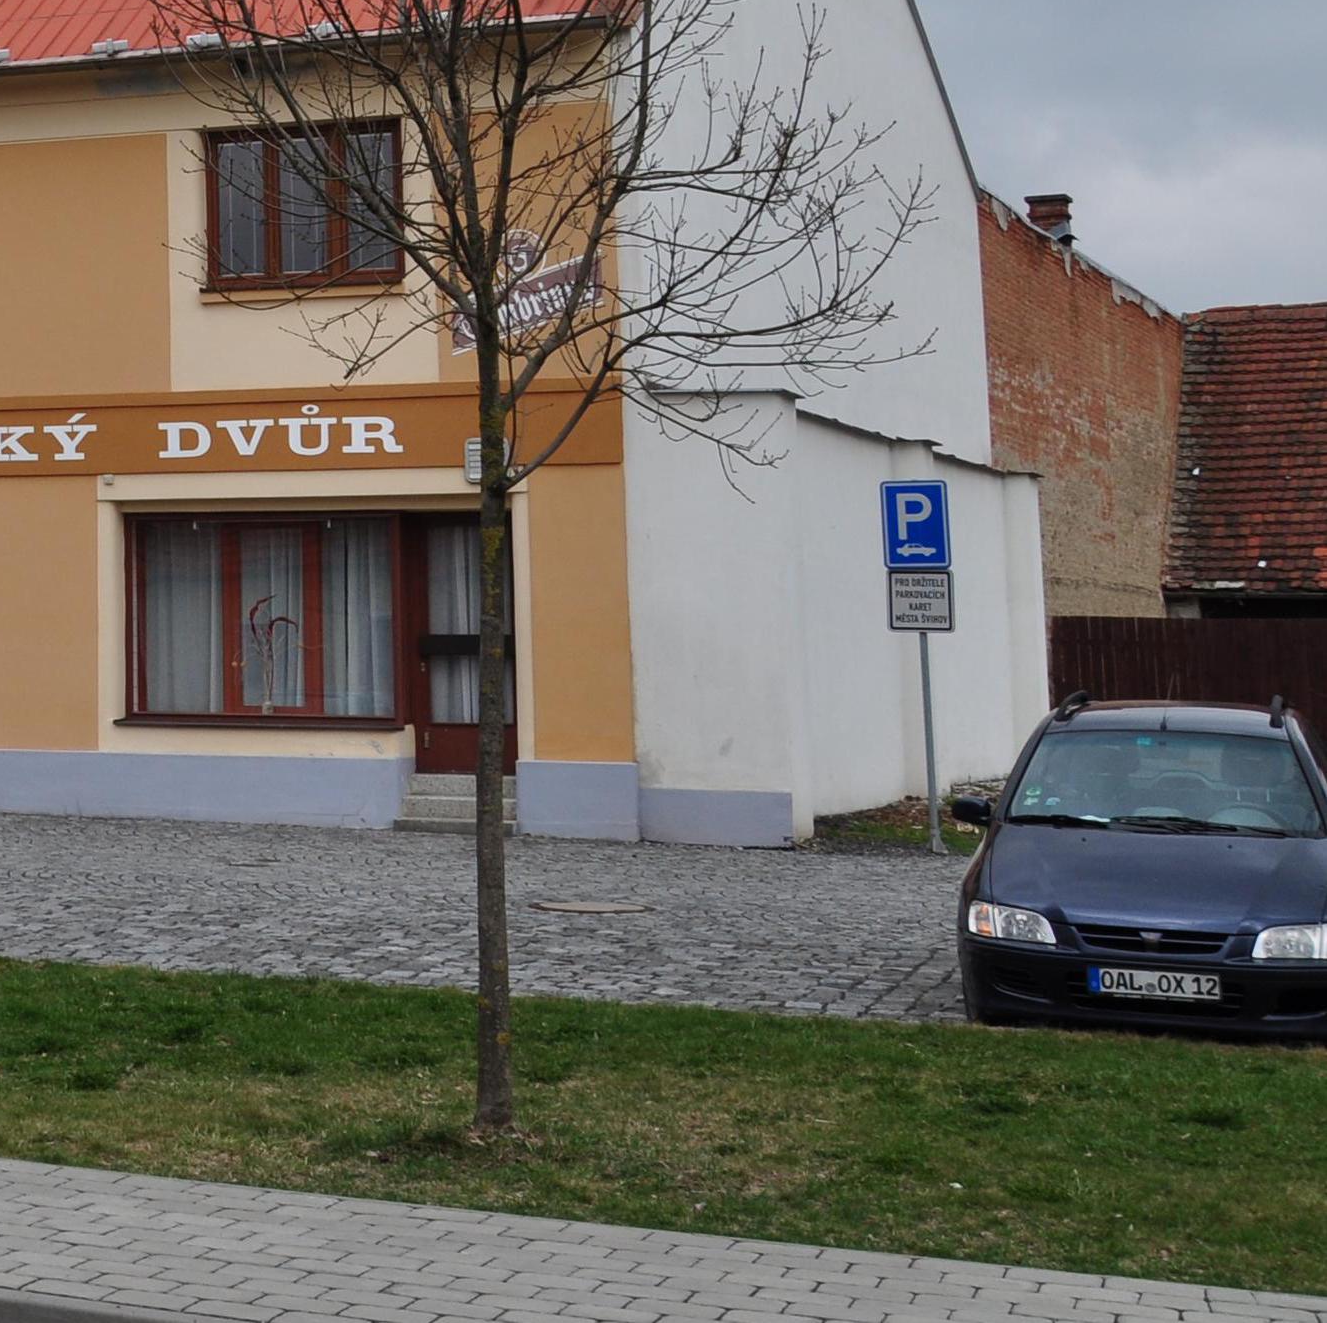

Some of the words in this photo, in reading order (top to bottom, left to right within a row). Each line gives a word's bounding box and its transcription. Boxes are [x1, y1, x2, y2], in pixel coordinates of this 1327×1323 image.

[158, 404, 404, 458] DVŮR
[896, 493, 932, 540] P
[895, 578, 909, 587] PRO
[911, 576, 945, 587] DRŽITELE
[895, 589, 945, 599] PARKOVACÍCH
[909, 602, 932, 611] KARET
[895, 612, 918, 623] MĚSTA
[1101, 971, 1143, 991] OAL
[1157, 975, 1186, 994] OX
[1192, 977, 1219, 996] 12
